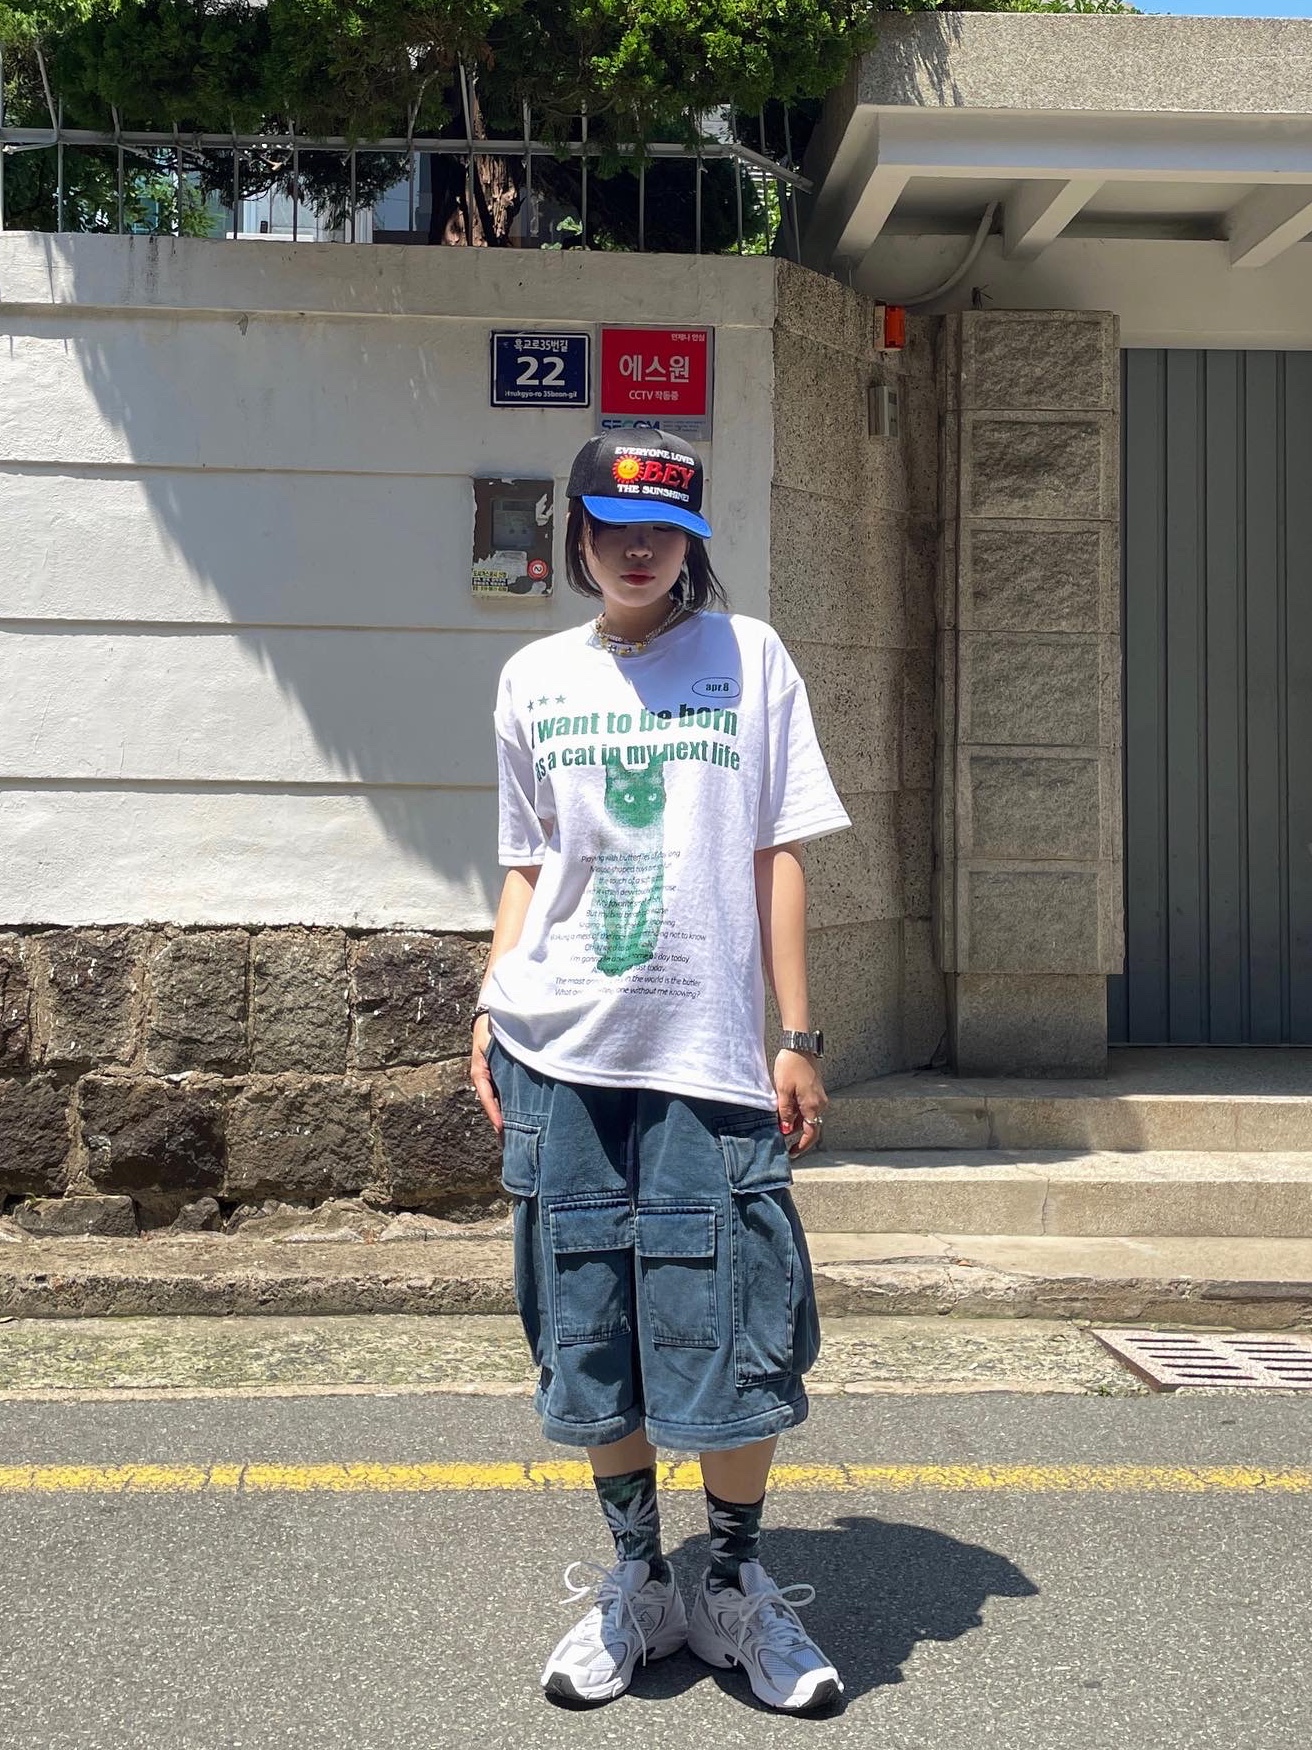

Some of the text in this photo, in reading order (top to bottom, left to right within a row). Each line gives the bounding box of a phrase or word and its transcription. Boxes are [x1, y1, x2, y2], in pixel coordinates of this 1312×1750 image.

[516, 356, 566, 386] 22
[619, 354, 690, 383] 에스원
[629, 390, 679, 401] CCTV 작동중
[614, 446, 695, 466] EVERYONE LOVES
[617, 484, 640, 493] THE
[537, 712, 600, 743] want
[607, 712, 632, 734] to
[639, 707, 672, 732] be
[679, 703, 738, 736] born
[547, 751, 557, 771] a
[562, 745, 596, 766] cat
[601, 744, 621, 765] in
[627, 745, 657, 767] my
[663, 740, 709, 762] next
[711, 741, 741, 771] life
[681, 932, 688, 940] to
[658, 953, 670, 962] day
[632, 975, 643, 983] the
[630, 987, 656, 995] without
[657, 988, 668, 996] me
